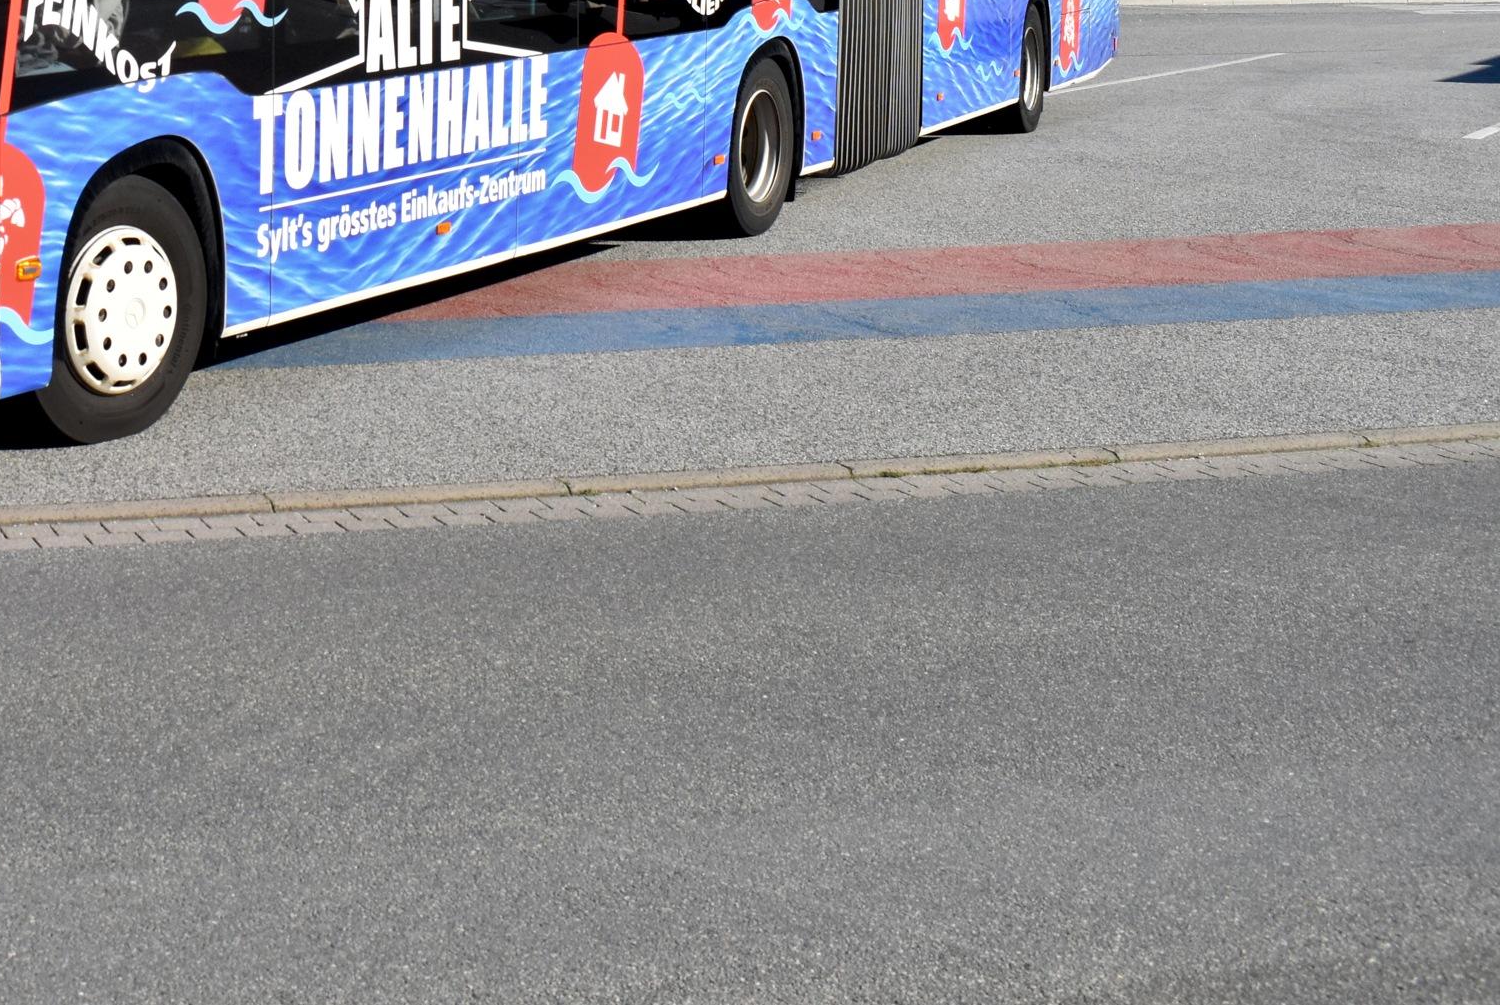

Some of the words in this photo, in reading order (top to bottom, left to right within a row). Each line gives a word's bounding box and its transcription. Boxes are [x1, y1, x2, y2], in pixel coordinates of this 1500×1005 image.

[252, 53, 549, 196] TONNENHALLE
[317, 202, 397, 253] grösstes
[401, 168, 547, 224] Einkaufs-Zentrum
